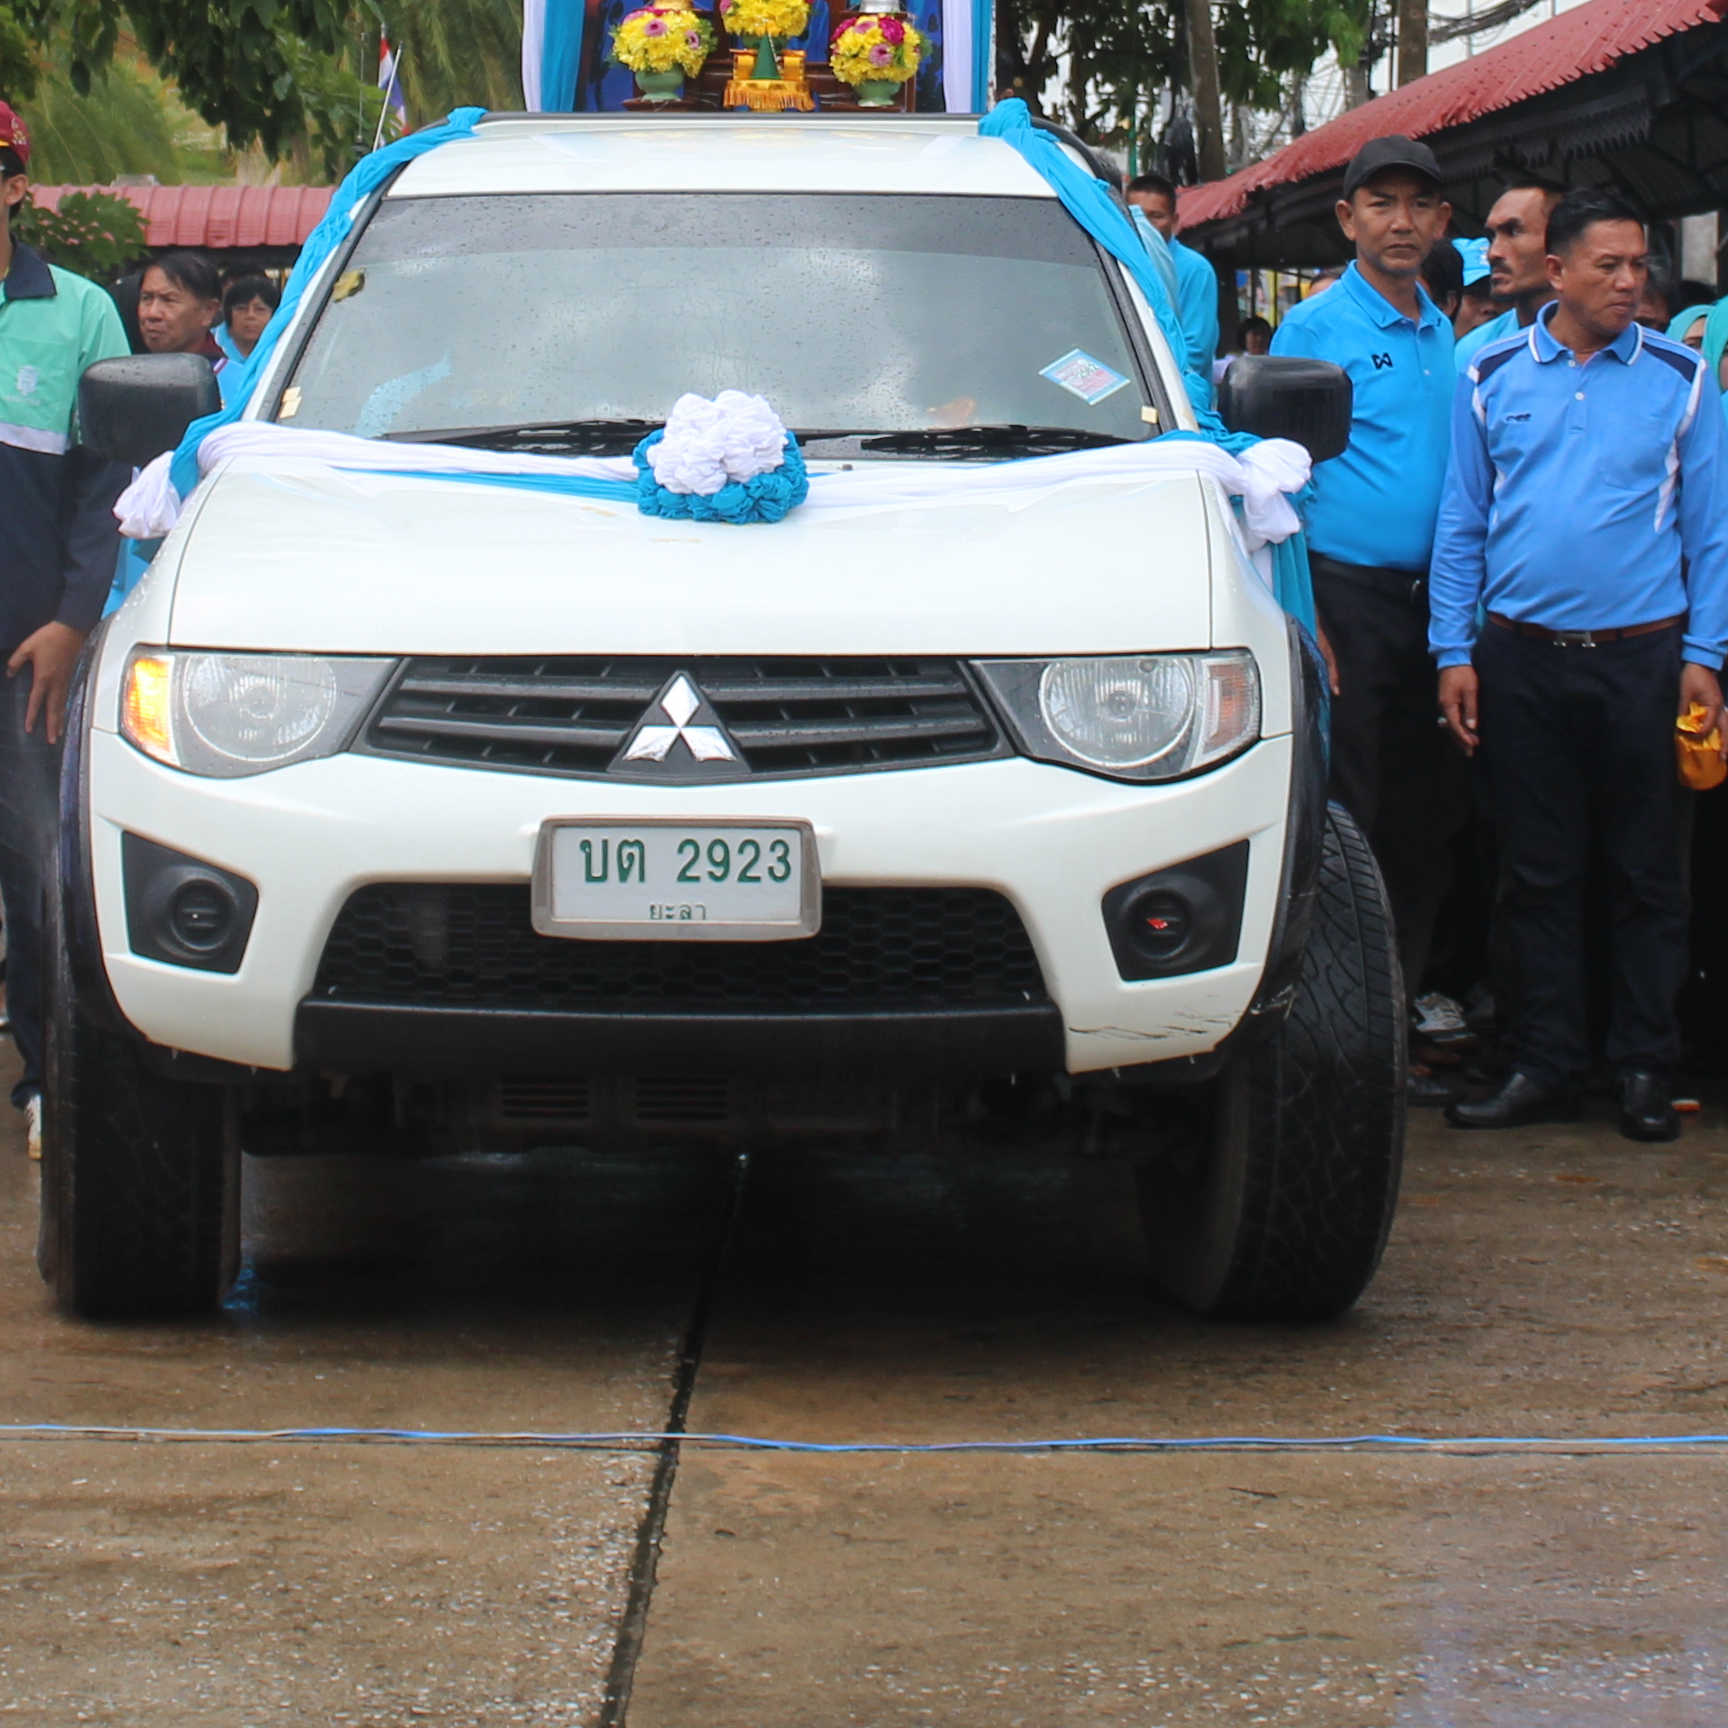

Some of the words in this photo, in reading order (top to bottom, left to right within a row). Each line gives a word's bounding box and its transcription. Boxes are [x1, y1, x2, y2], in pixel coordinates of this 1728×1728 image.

[579, 838, 646, 884] บต
[676, 838, 792, 883] 2923
[649, 902, 708, 920] ยะลา
